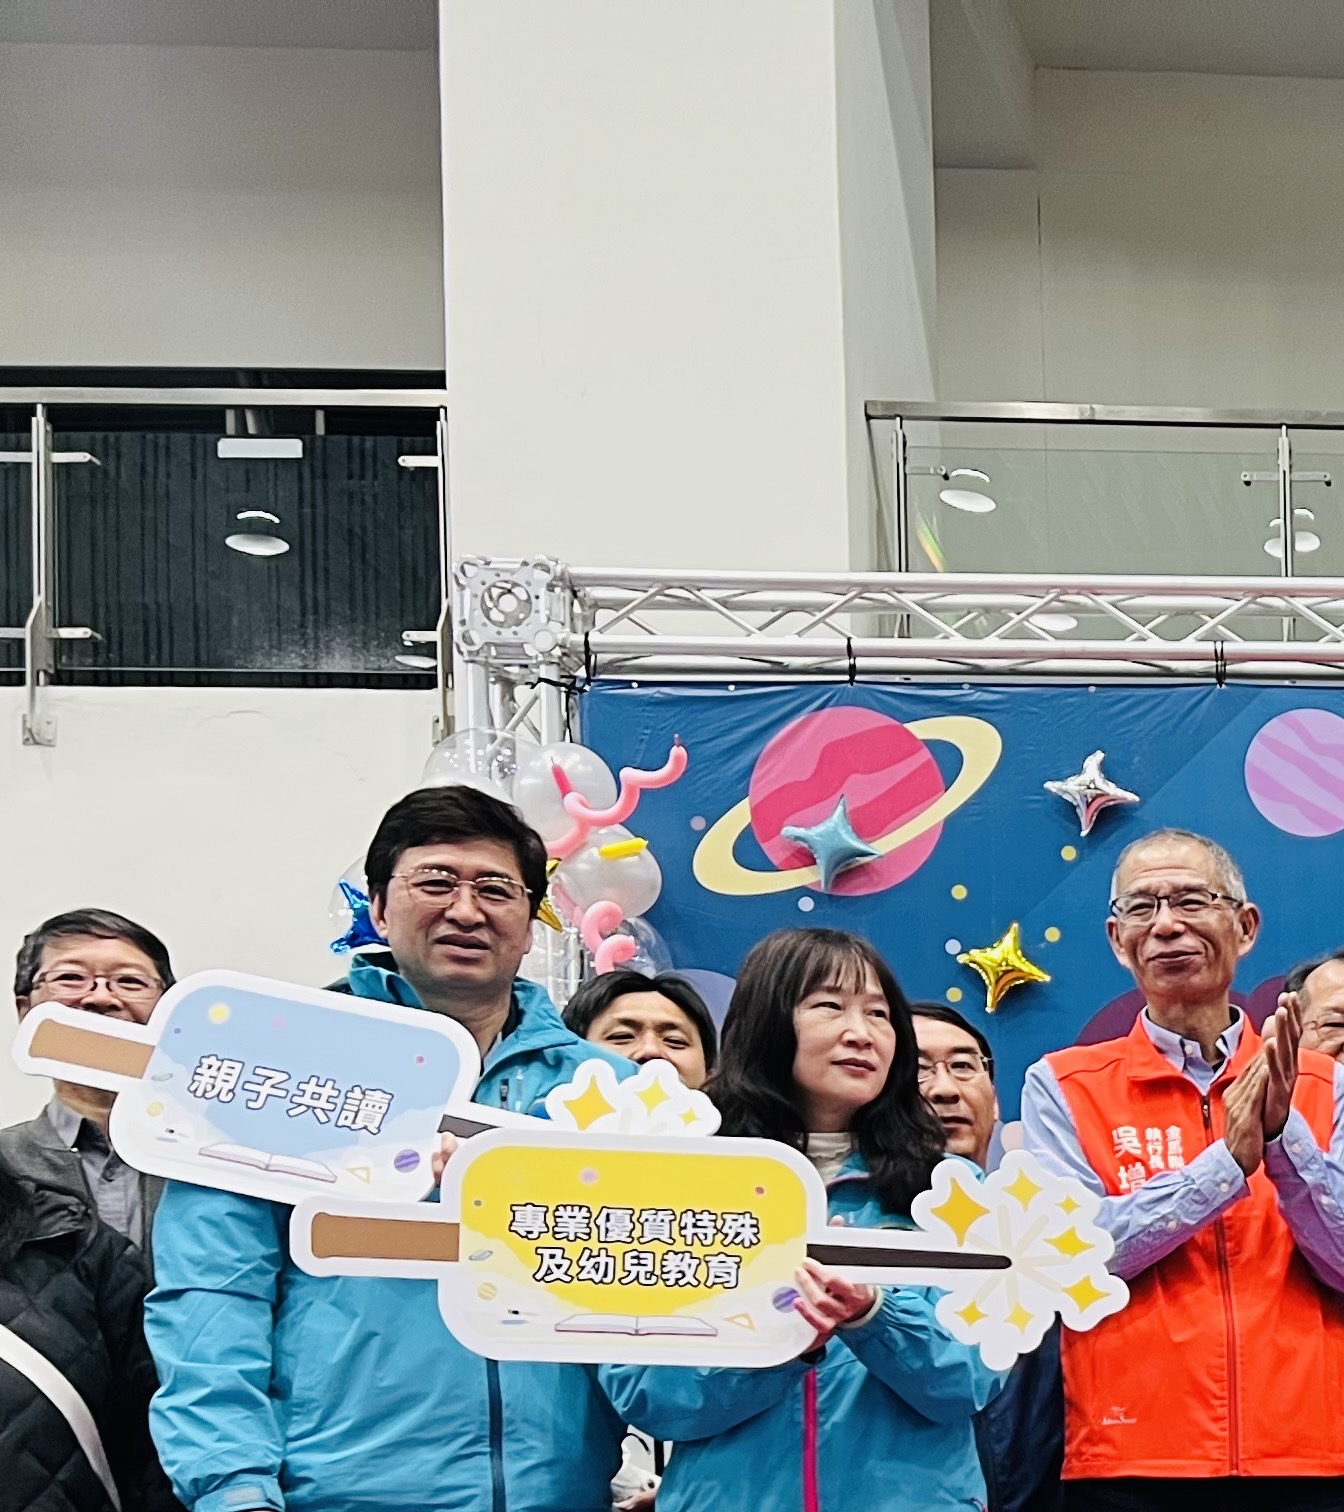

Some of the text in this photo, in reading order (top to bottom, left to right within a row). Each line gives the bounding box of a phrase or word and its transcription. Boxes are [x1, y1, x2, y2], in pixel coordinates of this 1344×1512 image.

[188, 1054, 395, 1135] 親子共讀
[509, 1203, 761, 1248] 專業優質特殊
[534, 1248, 743, 1289] 及幼兒教育
